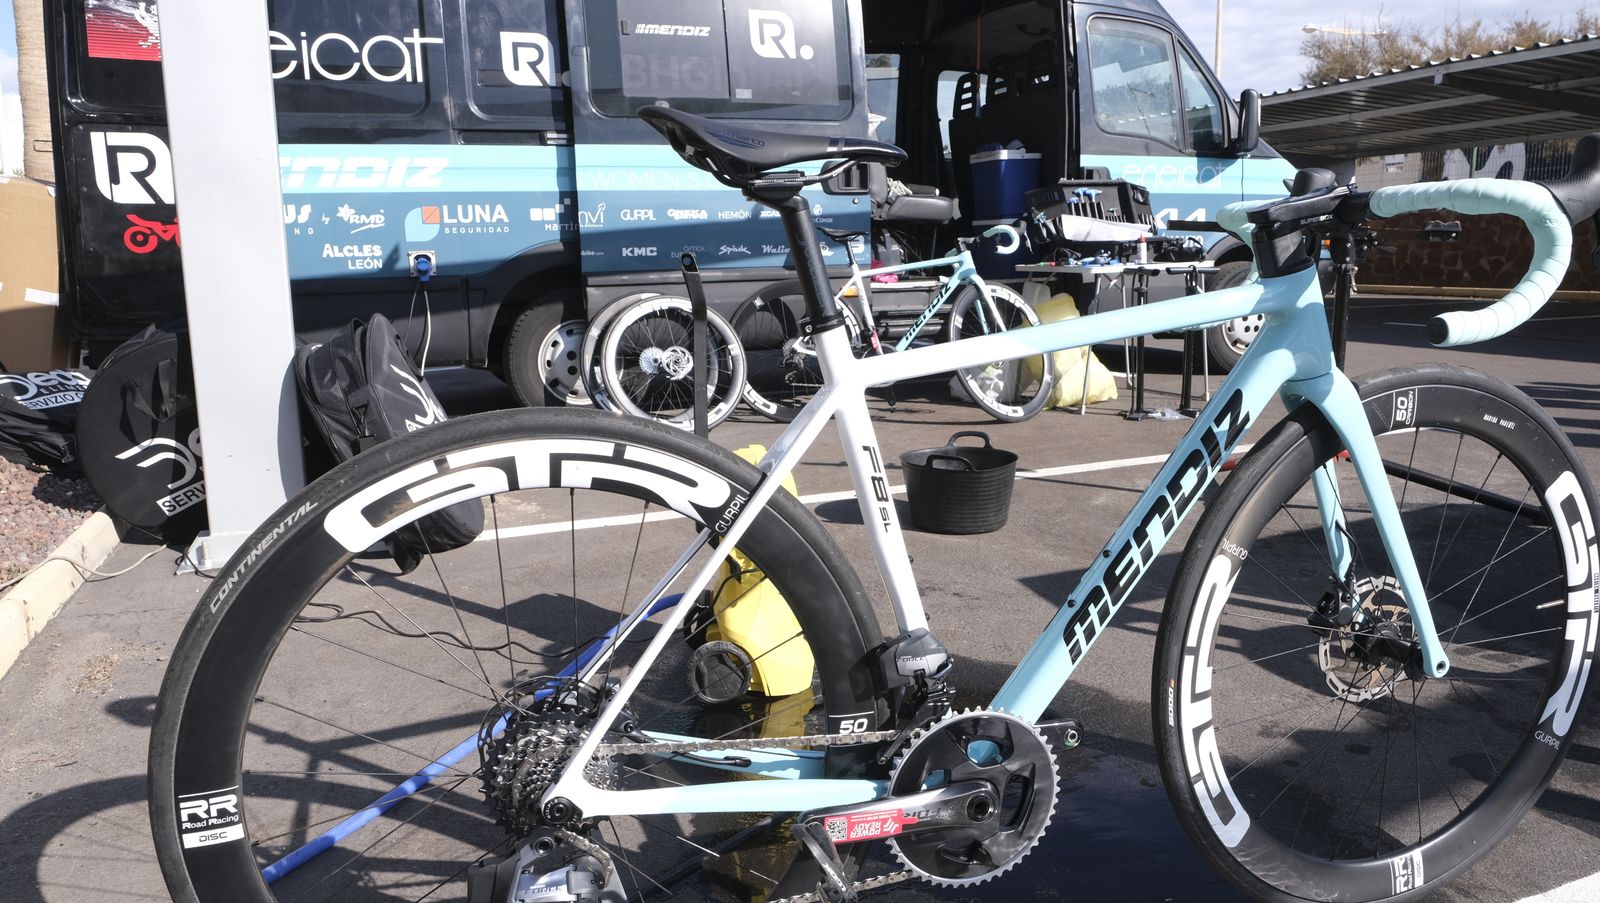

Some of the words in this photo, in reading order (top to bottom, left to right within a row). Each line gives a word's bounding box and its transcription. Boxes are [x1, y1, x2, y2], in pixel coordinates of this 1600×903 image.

[635, 24, 711, 37] MENDIZ
[442, 204, 509, 224] LUNA
[620, 209, 656, 221] GURPIL
[444, 226, 510, 234] SEGURIDAD
[322, 243, 383, 258] ALCLES
[622, 247, 658, 257] KMC
[347, 257, 383, 270] LEÓN
[1395, 396, 1408, 422] 50
[862, 445, 888, 503] F8
[161, 483, 206, 513] SERV
[715, 490, 749, 534] GURPIL
[209, 500, 319, 614] CONTINENTAL
[1222, 538, 1248, 560] GURPIL
[839, 718, 869, 734] 50
[1534, 730, 1561, 751] GURPIL
[180, 794, 239, 822] RR
[182, 819, 207, 830] Road
[208, 814, 239, 826] Racing
[854, 820, 881, 831] READY
[199, 831, 228, 843] DISC
[849, 828, 881, 839] POWER
